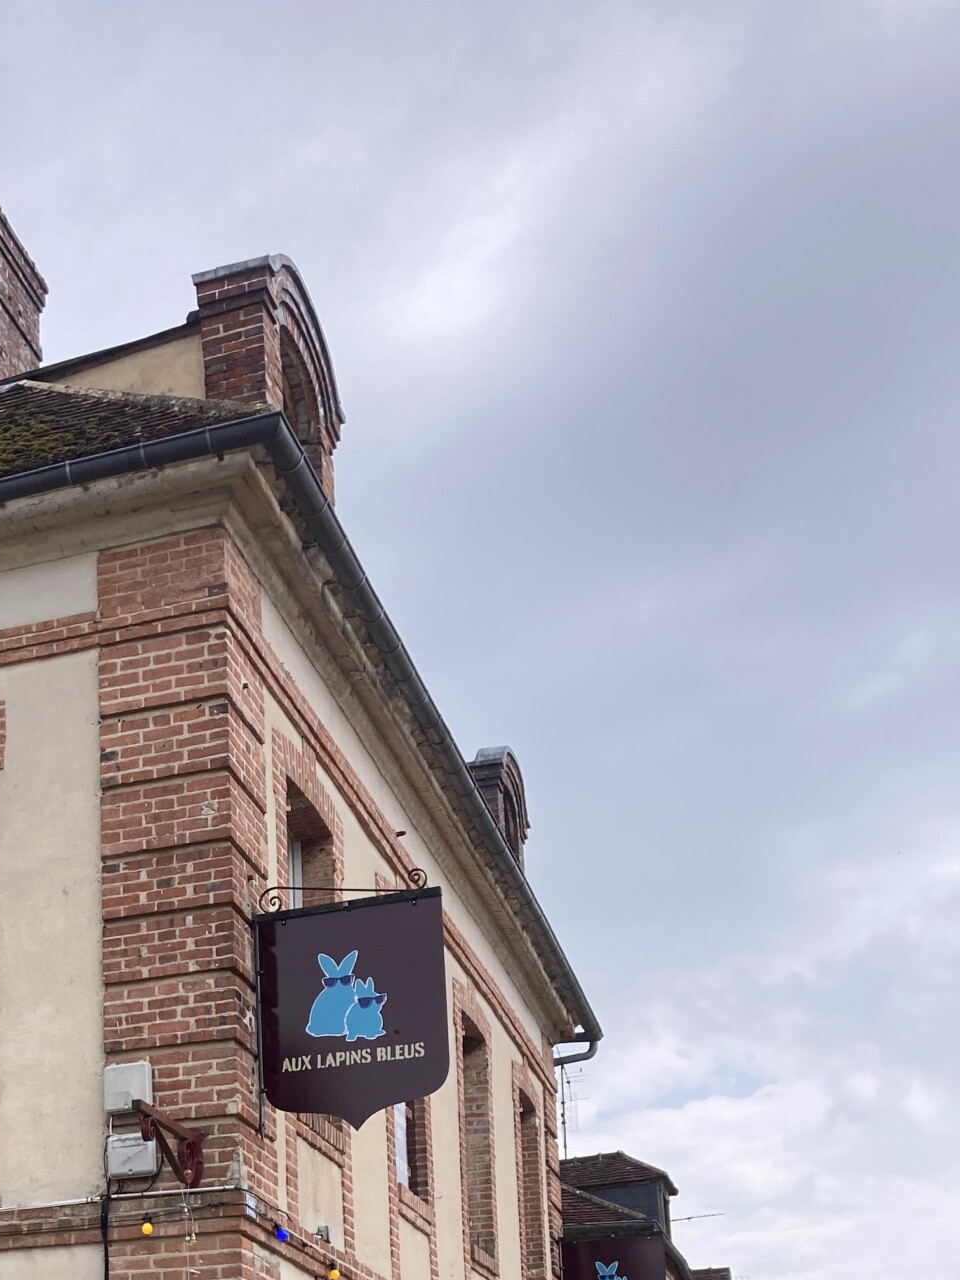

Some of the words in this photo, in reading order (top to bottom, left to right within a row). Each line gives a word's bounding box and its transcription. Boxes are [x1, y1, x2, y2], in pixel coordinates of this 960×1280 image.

[281, 1055, 312, 1073] AUX
[317, 1048, 372, 1069] LAPINS
[377, 1042, 425, 1061] BLEUS
